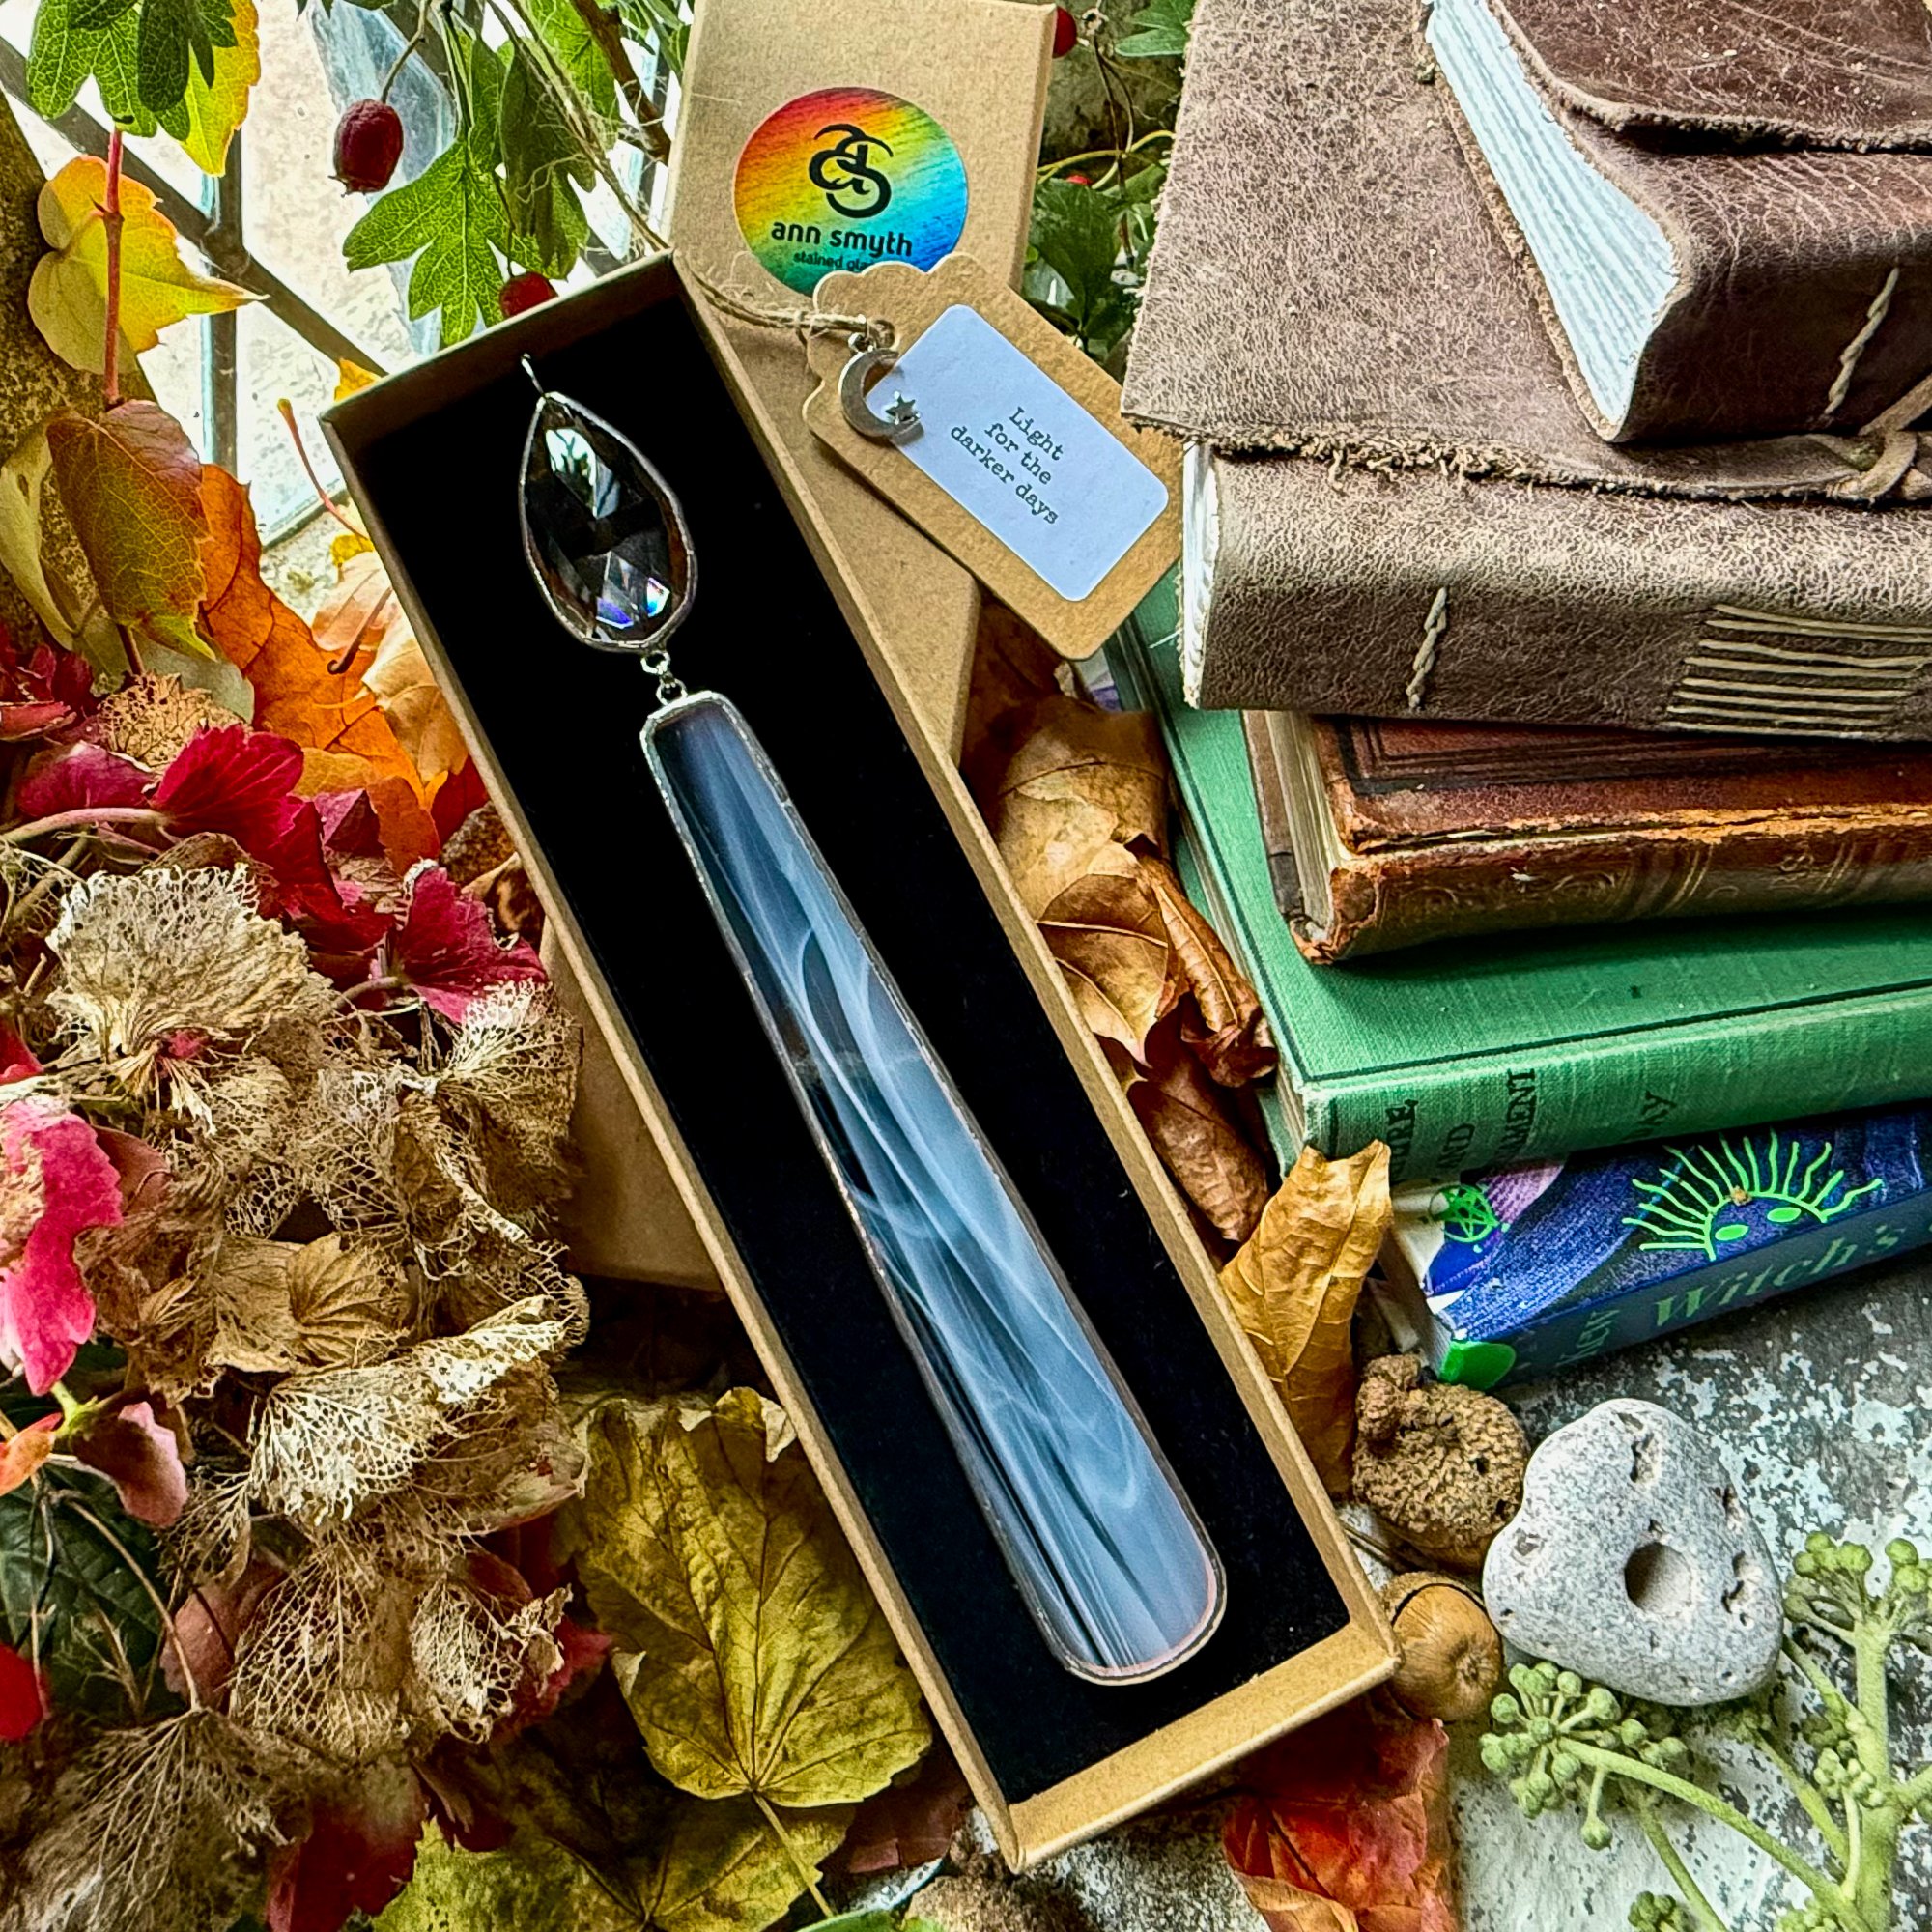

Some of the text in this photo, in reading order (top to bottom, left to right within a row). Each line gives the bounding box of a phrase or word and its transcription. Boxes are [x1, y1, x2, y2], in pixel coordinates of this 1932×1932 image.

[771, 221, 913, 258] ann smyth
[793, 250, 843, 269] stained
[983, 422, 1052, 485] for the
[1009, 406, 1064, 461] Light
[951, 425, 1059, 525] darker days
